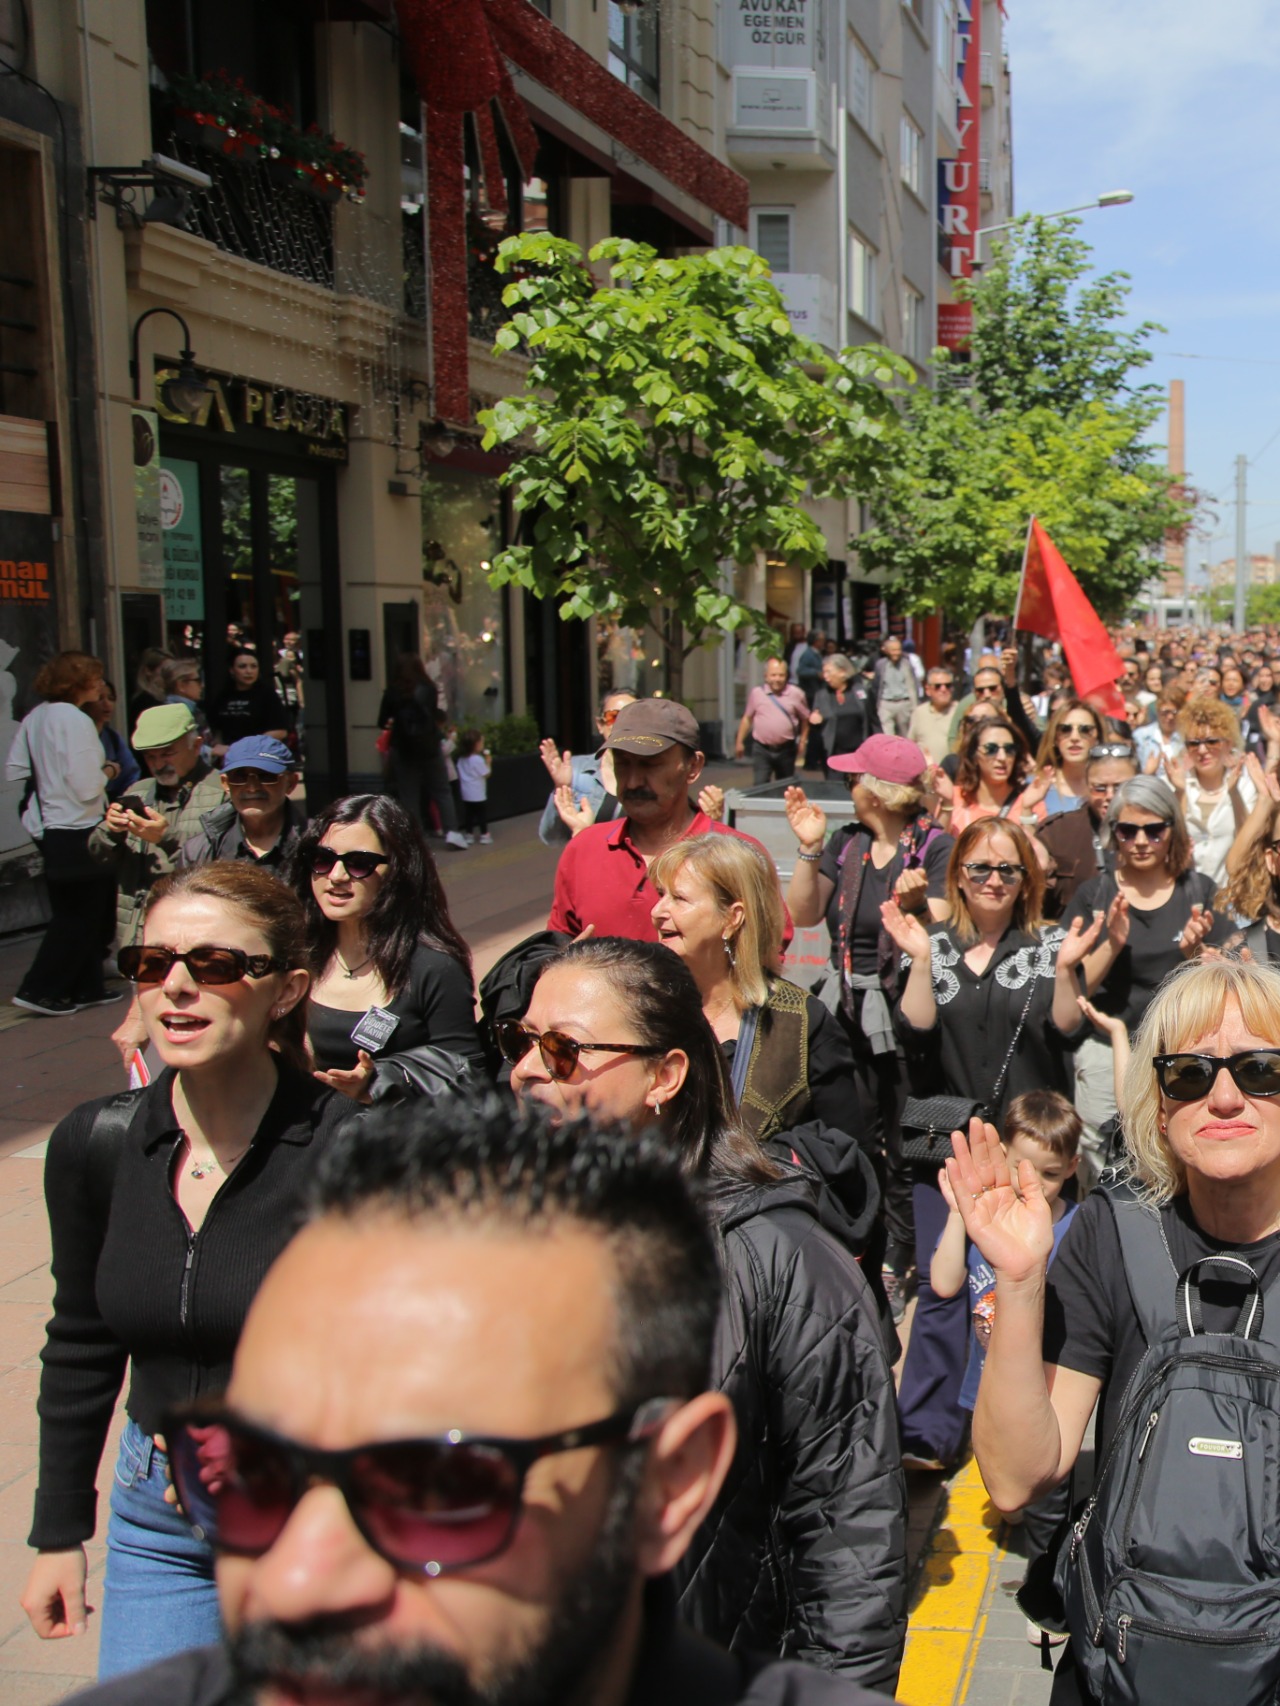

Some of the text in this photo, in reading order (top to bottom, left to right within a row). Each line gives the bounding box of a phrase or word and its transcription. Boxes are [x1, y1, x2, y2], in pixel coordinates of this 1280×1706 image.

[739, 0, 806, 12] AVUKAT
[744, 15, 805, 28] EGEMEN
[752, 29, 806, 45] ÖZGÜR
